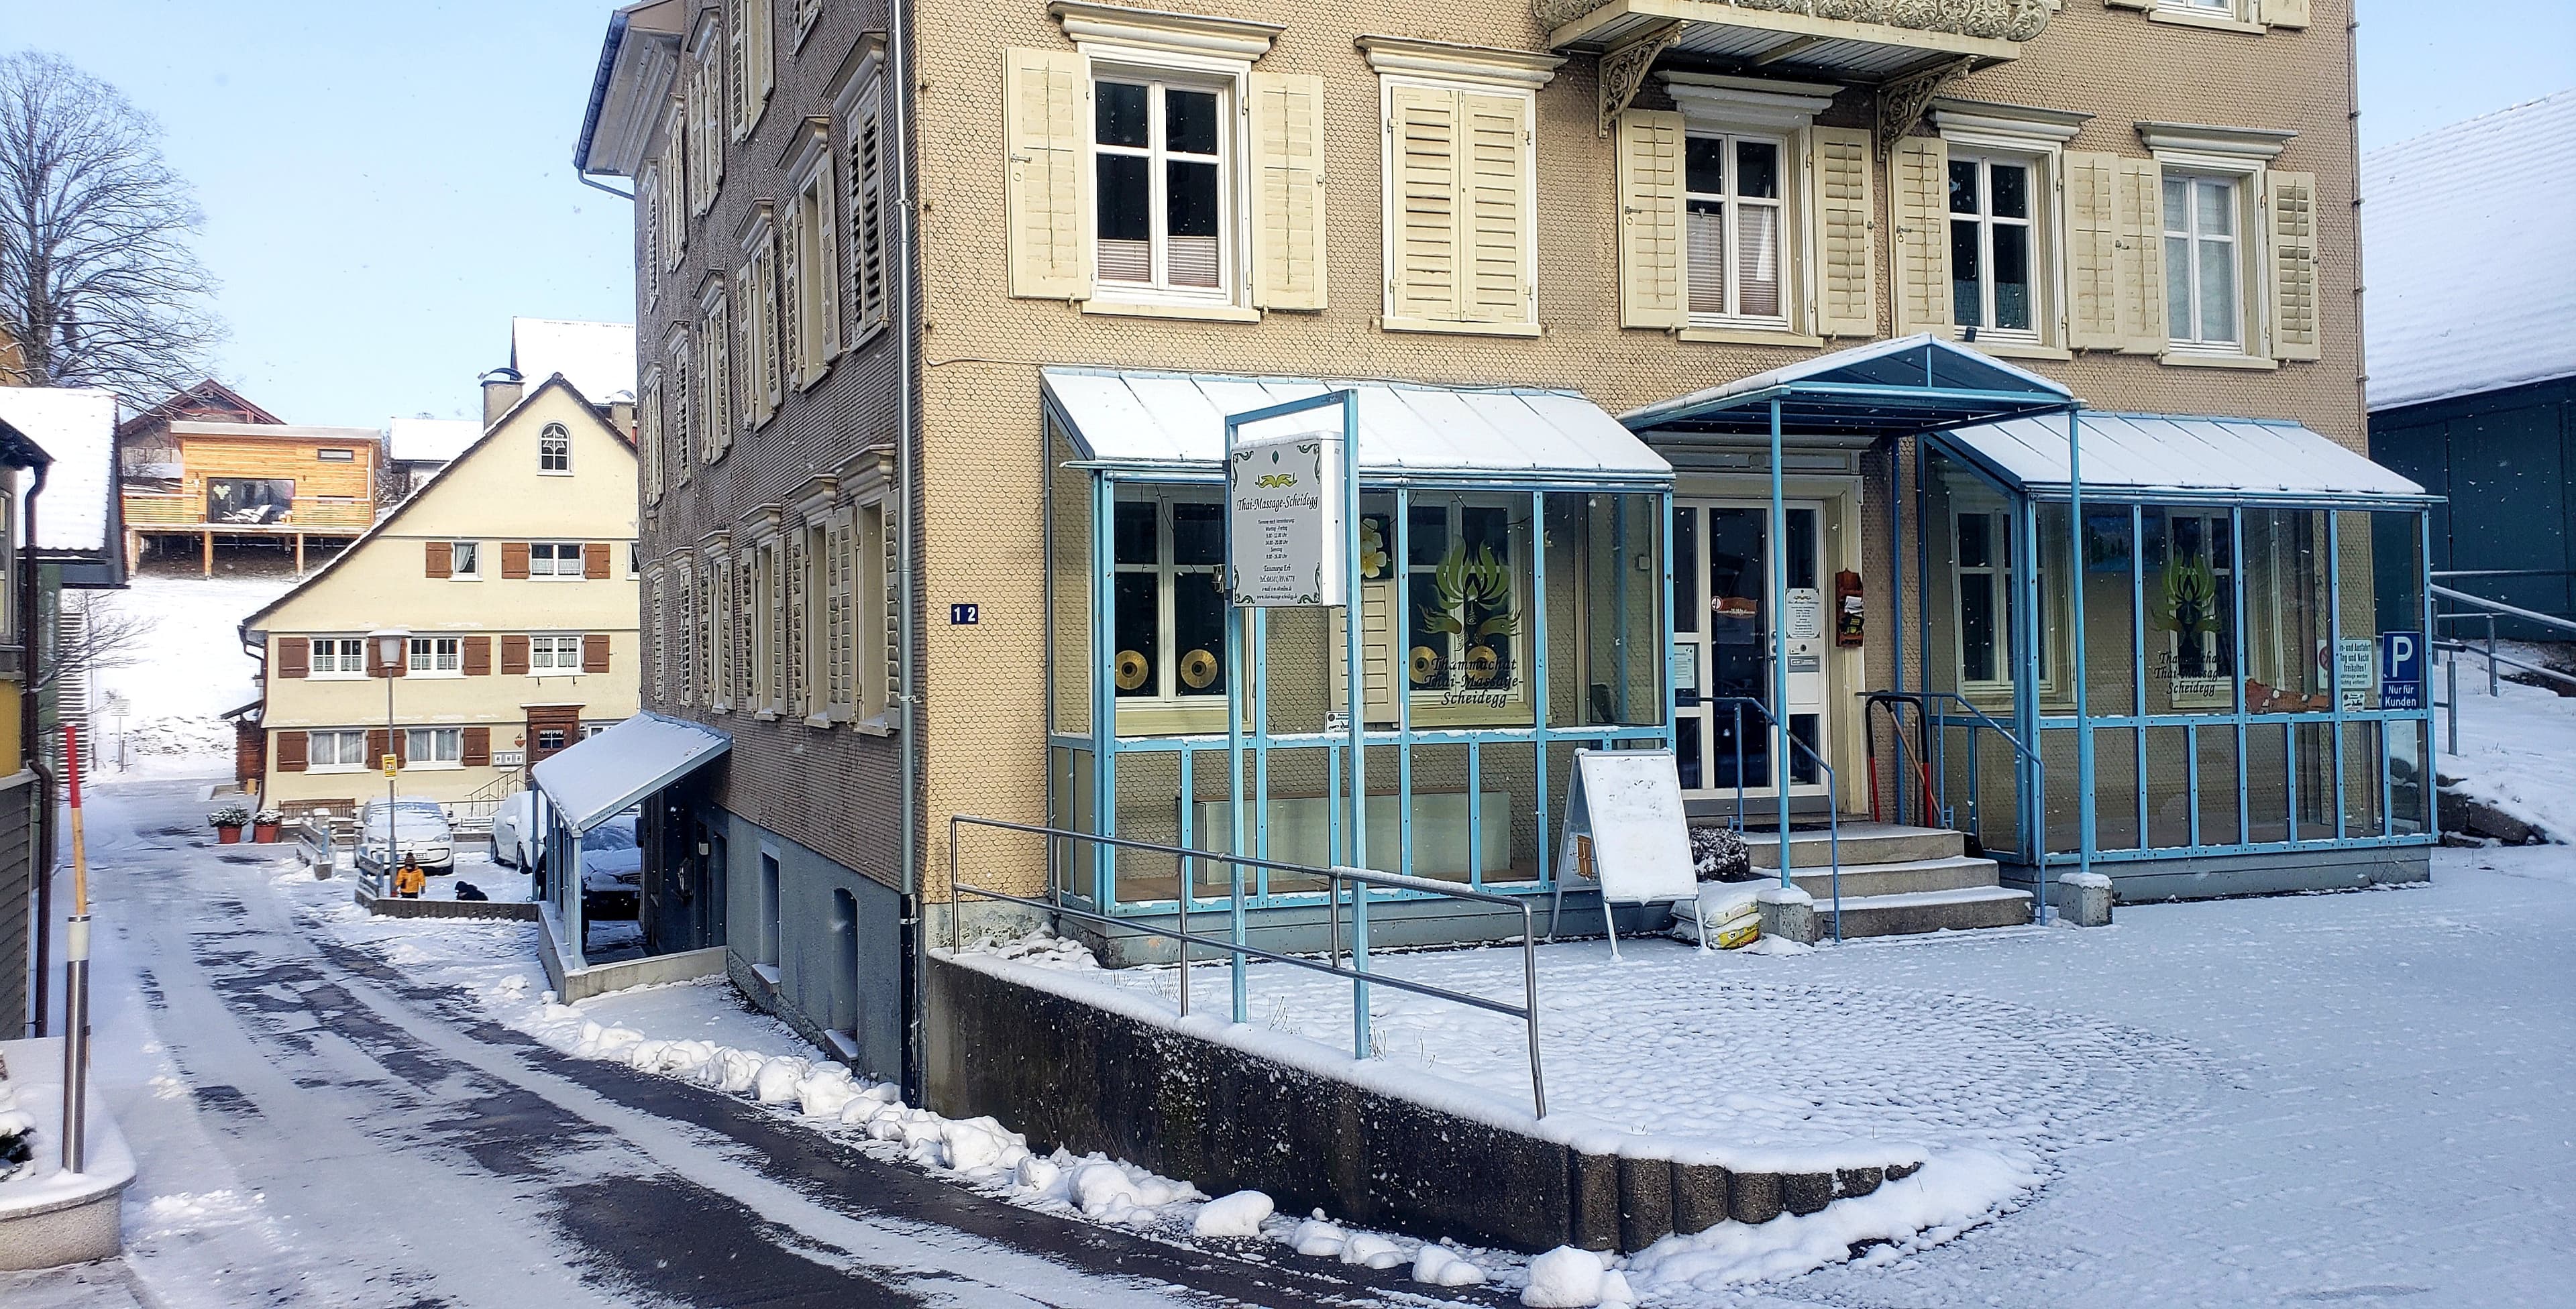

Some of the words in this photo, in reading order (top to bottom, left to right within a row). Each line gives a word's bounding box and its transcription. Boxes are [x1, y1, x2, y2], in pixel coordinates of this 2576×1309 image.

[1236, 492, 1318, 512] Thai-Massage-Scheidegg
[2354, 642, 2371, 651] Ausfahrt
[2348, 653, 2356, 662] und
[2357, 653, 2369, 662] Nacht
[2392, 636, 2413, 678] P
[2166, 681, 2216, 697] Scheidegg
[2388, 685, 2402, 694] Nur
[2404, 685, 2414, 694] für
[1441, 689, 1508, 708] Scheidegg
[2385, 696, 2416, 707] Kunden
